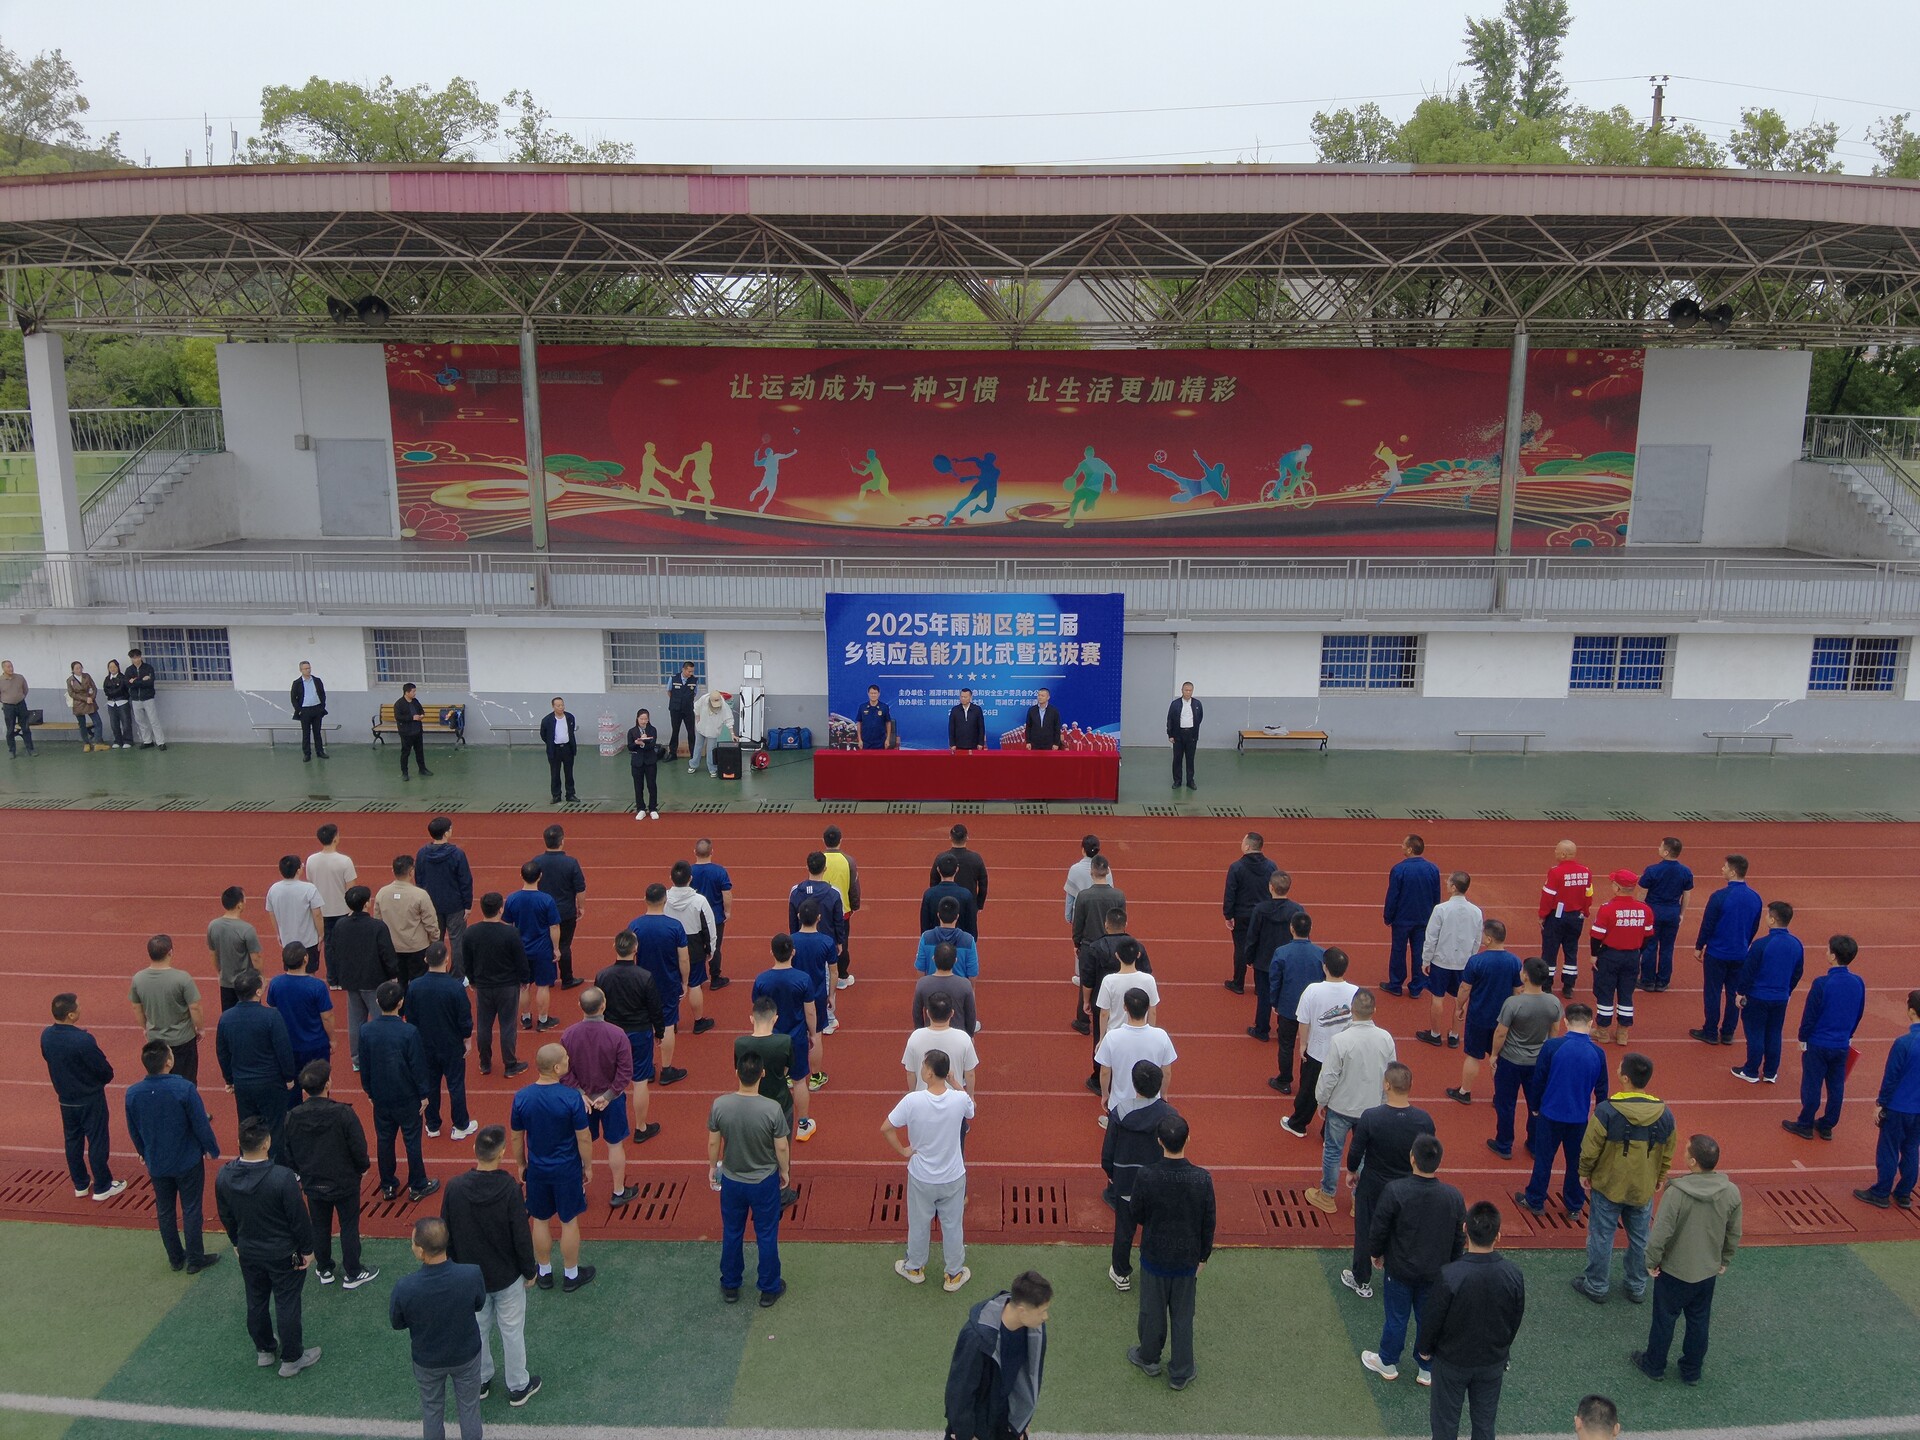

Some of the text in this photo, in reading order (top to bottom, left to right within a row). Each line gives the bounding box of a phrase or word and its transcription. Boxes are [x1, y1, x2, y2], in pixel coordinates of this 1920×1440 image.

[729, 373, 1238, 404] 让运动成为一种习惯 让生活更加精彩
[866, 612, 1079, 637] 2025年雨湖区第三届
[844, 641, 1101, 666] 乡镇应急能力比武暨选拔赛
